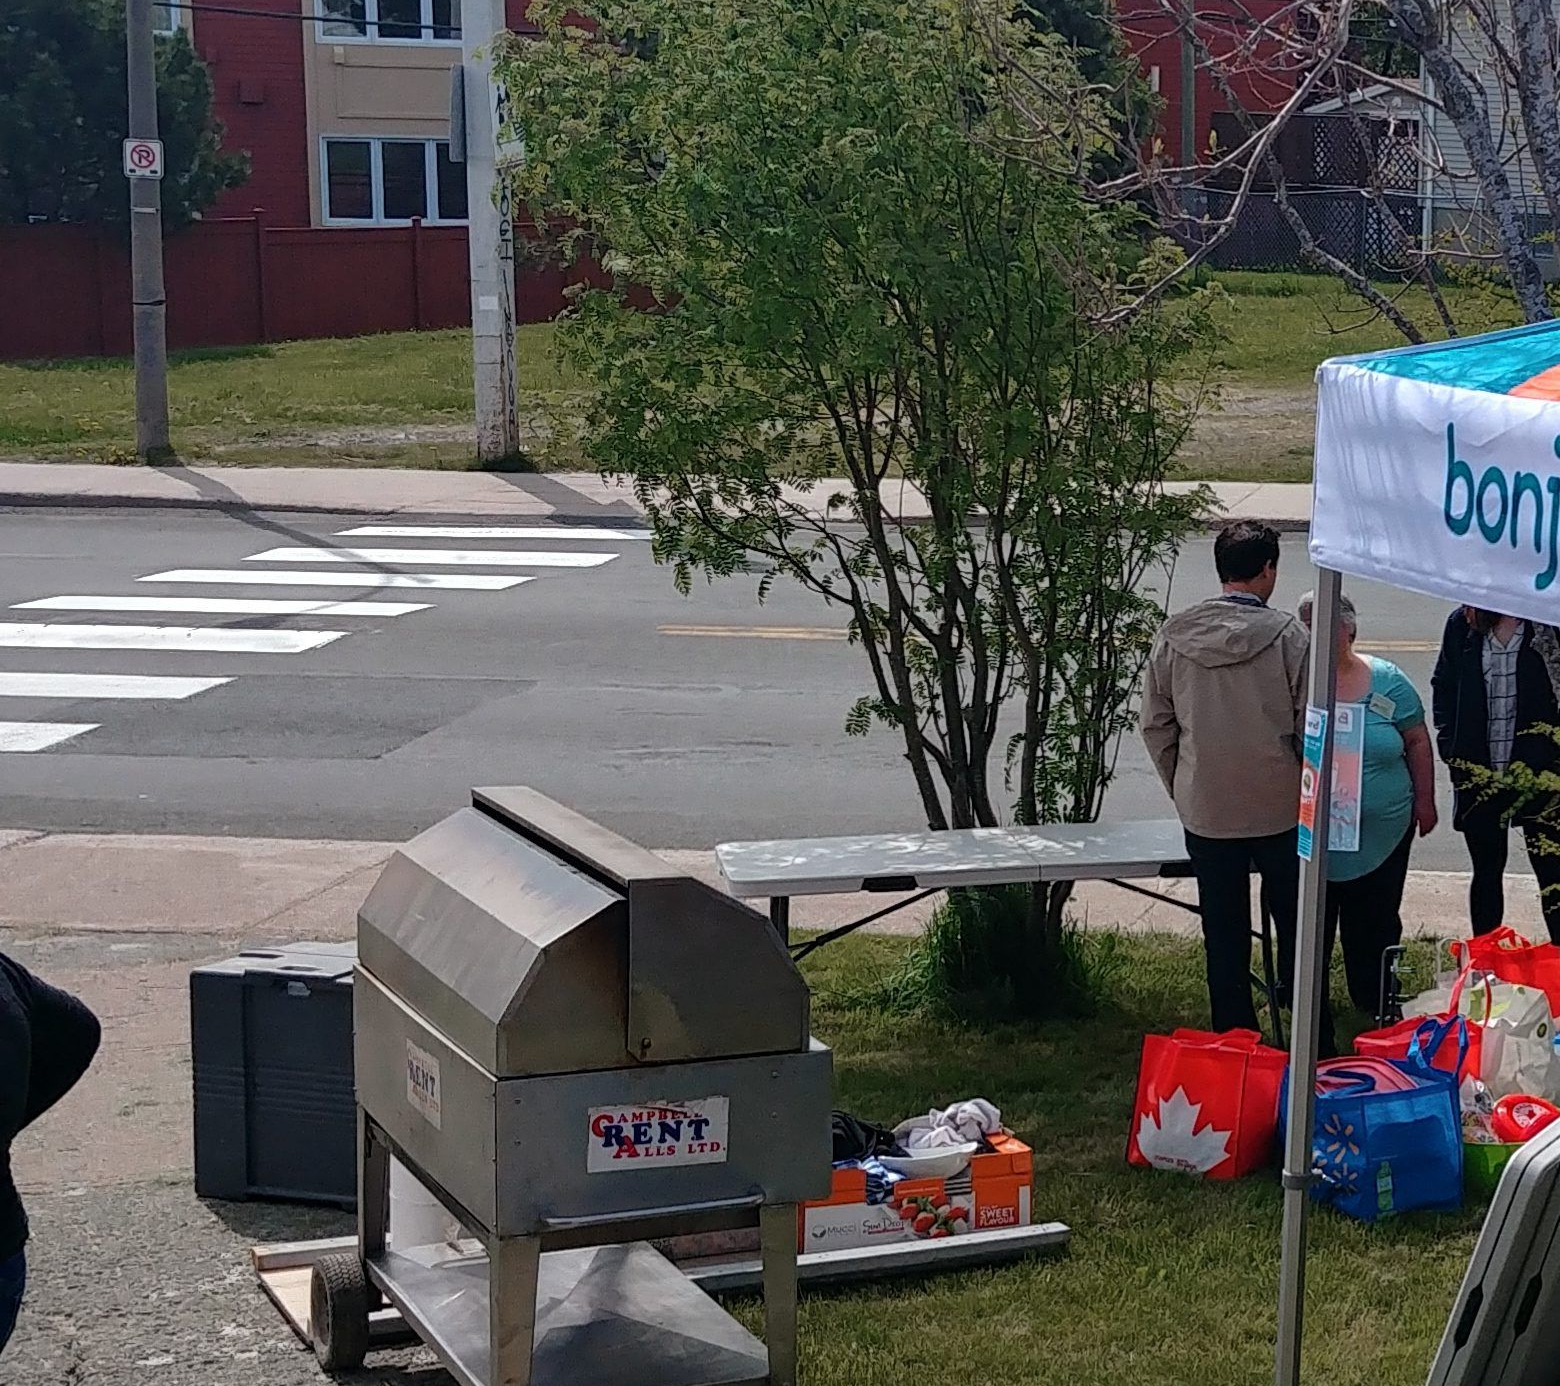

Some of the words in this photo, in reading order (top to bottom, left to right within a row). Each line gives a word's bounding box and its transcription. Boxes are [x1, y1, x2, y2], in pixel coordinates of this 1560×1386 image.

[602, 1118, 710, 1148] RENT
[612, 1135, 676, 1159] ALLS
[687, 1141, 726, 1154] LTD.
[980, 1207, 1015, 1219] SWEET
